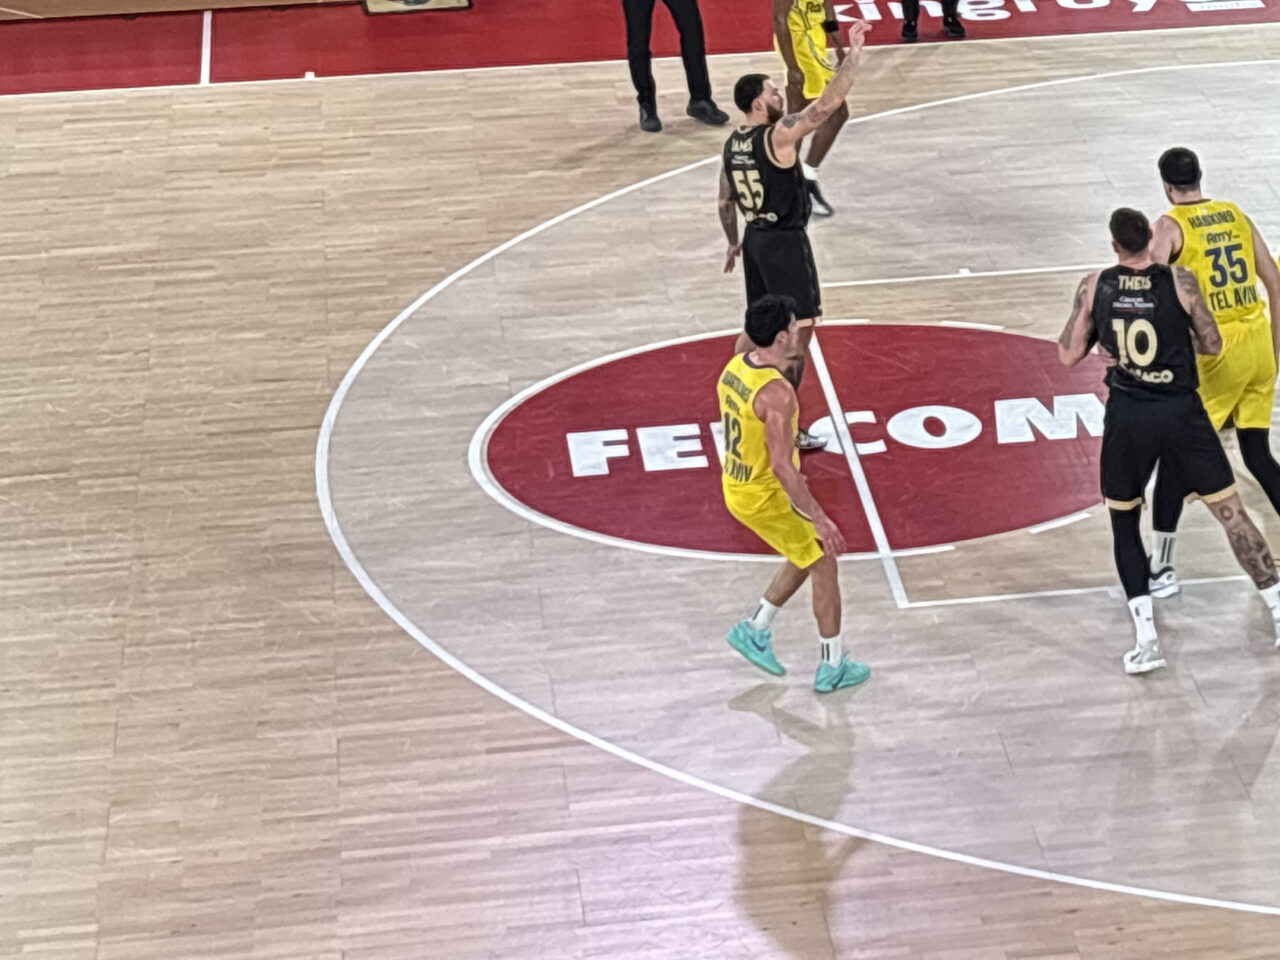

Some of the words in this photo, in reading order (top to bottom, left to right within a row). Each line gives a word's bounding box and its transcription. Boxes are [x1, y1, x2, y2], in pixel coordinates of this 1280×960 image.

[732, 170, 764, 210] 55
[1118, 275, 1153, 290] THEIS
[1205, 243, 1249, 288] 35
[1208, 289, 1233, 311] TEL
[1112, 319, 1158, 366] 10
[566, 393, 1106, 477] FECOM
[723, 412, 742, 460] 12
